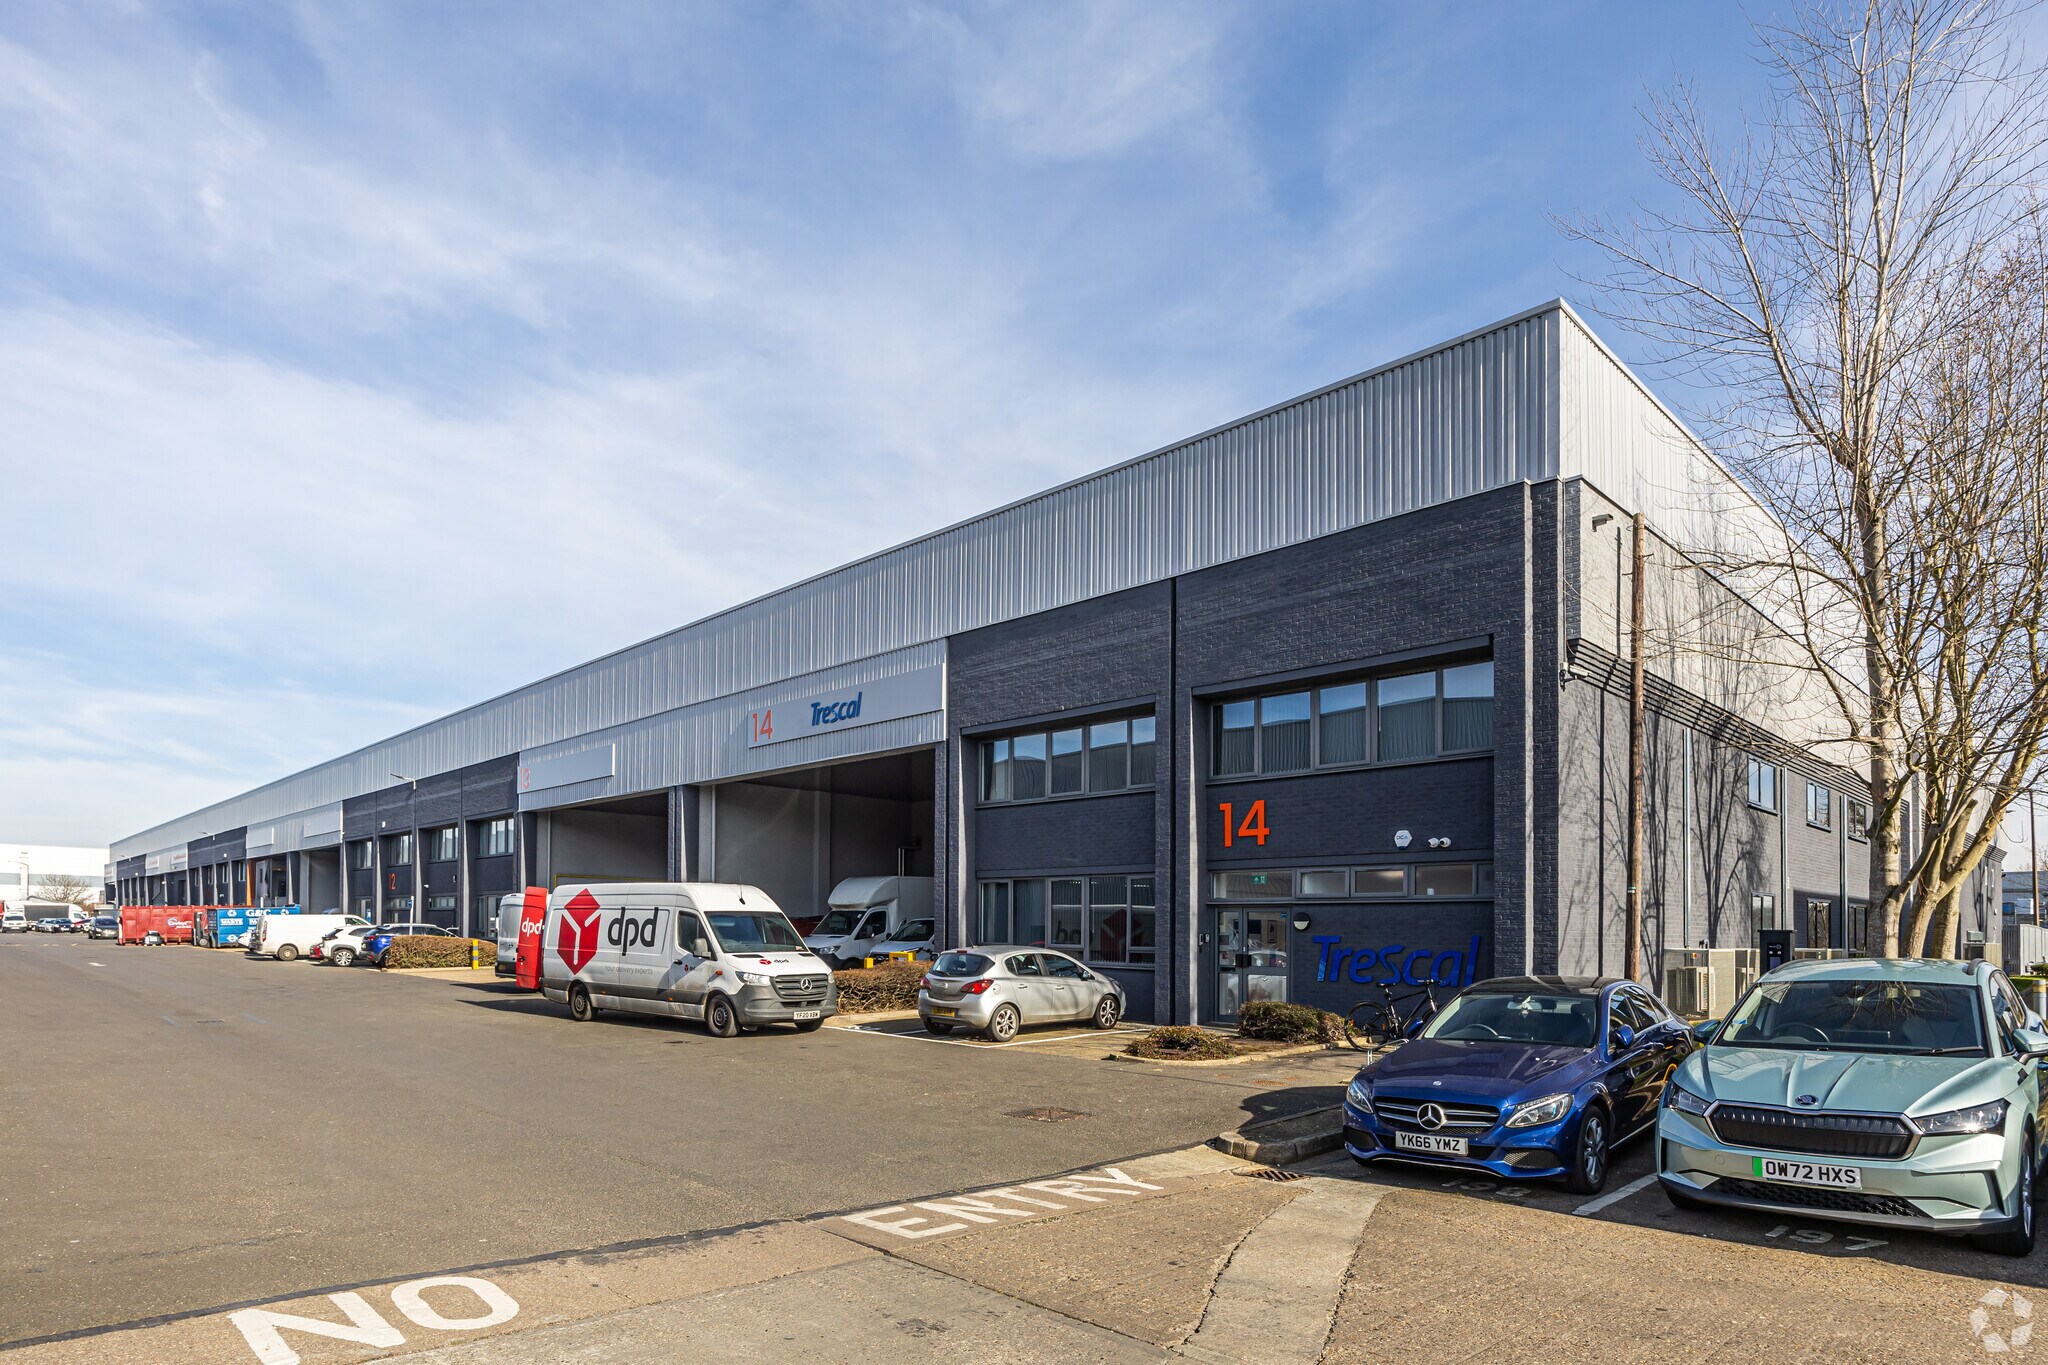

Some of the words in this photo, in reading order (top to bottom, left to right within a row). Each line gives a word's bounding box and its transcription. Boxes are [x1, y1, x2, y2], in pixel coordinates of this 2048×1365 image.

[753, 710, 773, 742] 14
[811, 692, 862, 726] Trescal
[520, 767, 530, 790] 13
[1219, 799, 1271, 848] 14
[388, 873, 396, 890] 12
[521, 916, 543, 937] dpd
[607, 906, 659, 957] dpd
[1312, 935, 1481, 988] Trescal
[1400, 1133, 1431, 1149] YK66
[1434, 1137, 1460, 1152] YMZ
[1765, 1160, 1813, 1179] OW72
[1818, 1166, 1856, 1184] HXS
[1764, 1225, 1889, 1251] 197
[226, 1276, 520, 1365] NO
[840, 1168, 1165, 1239] ENTRY
